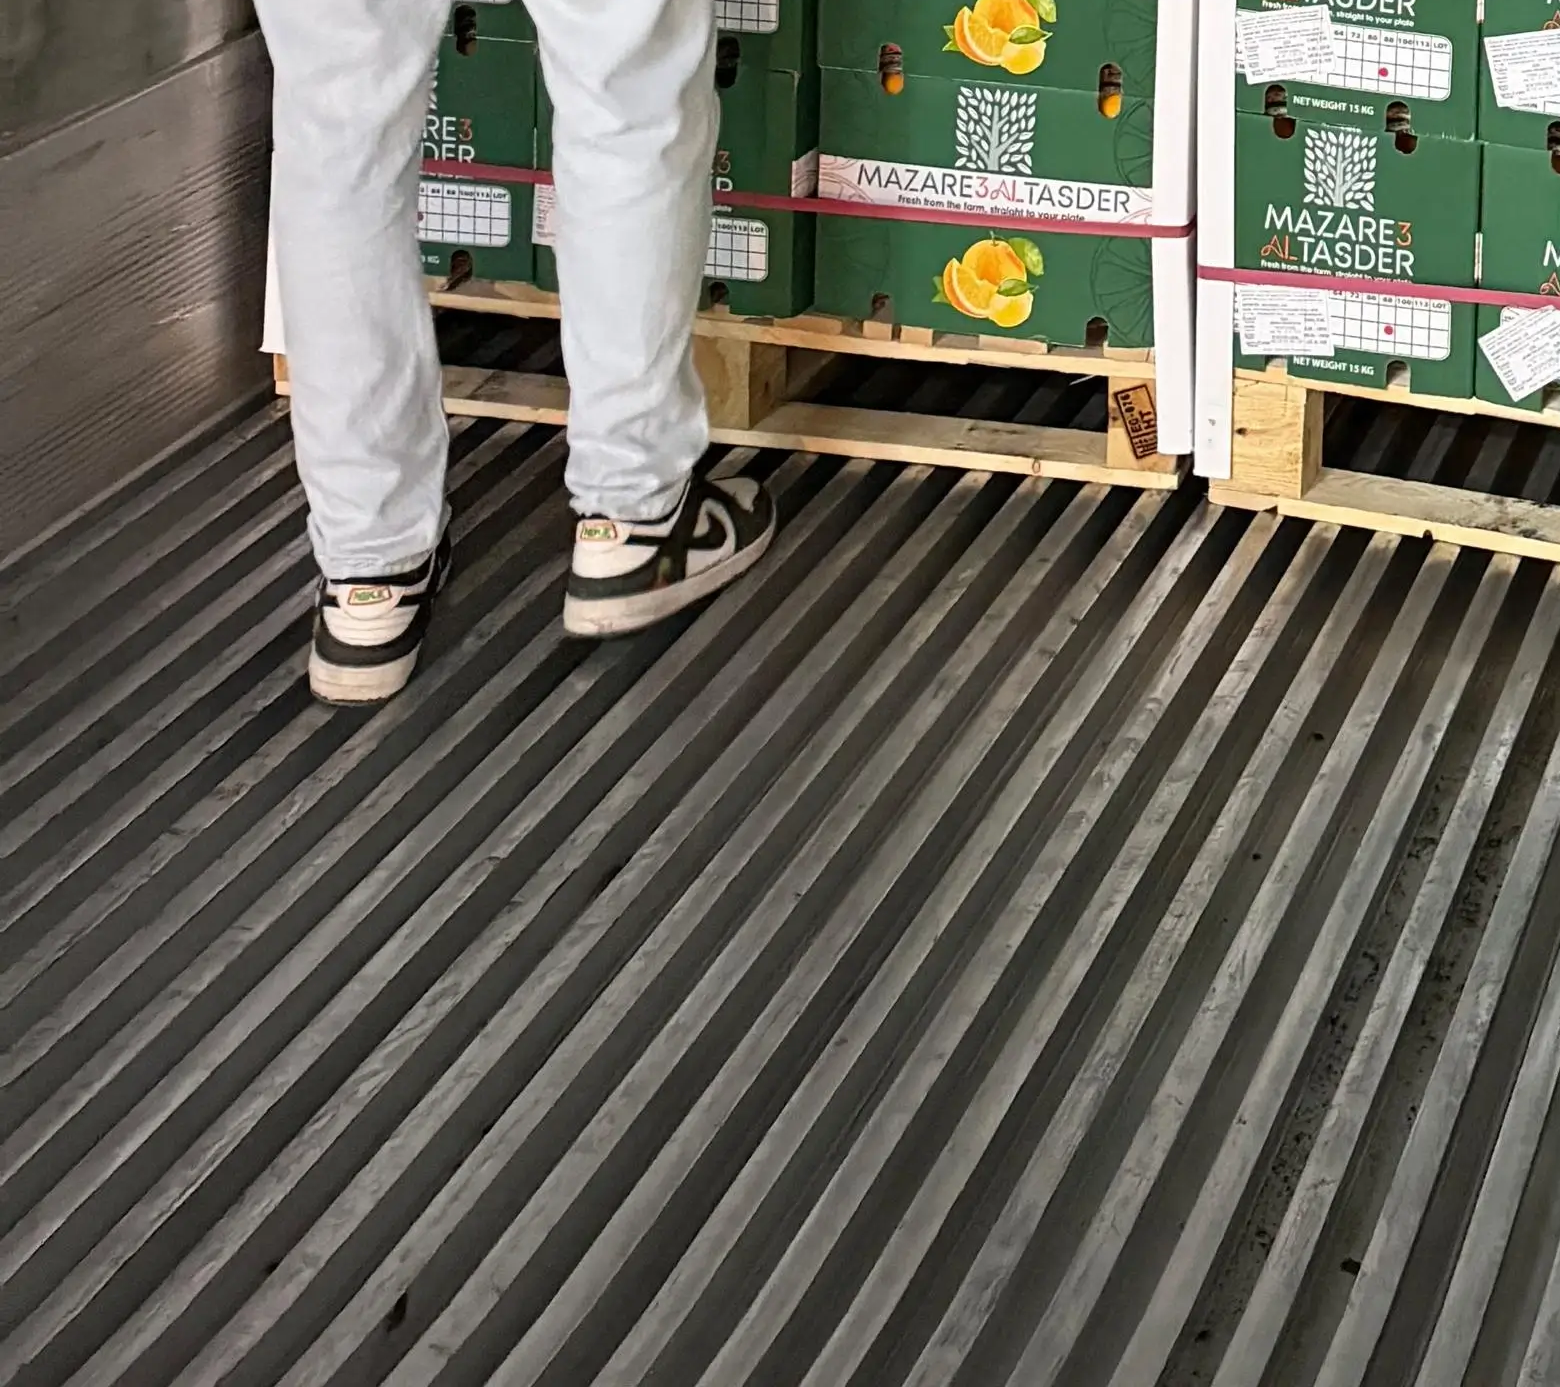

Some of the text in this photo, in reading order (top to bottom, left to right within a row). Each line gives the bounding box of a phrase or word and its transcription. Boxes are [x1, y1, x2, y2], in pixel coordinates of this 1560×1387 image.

[858, 162, 1130, 213] MAZARE3ALTASDER
[1264, 204, 1412, 246] MAZARE3
[1261, 235, 1415, 276] ALTASDER
